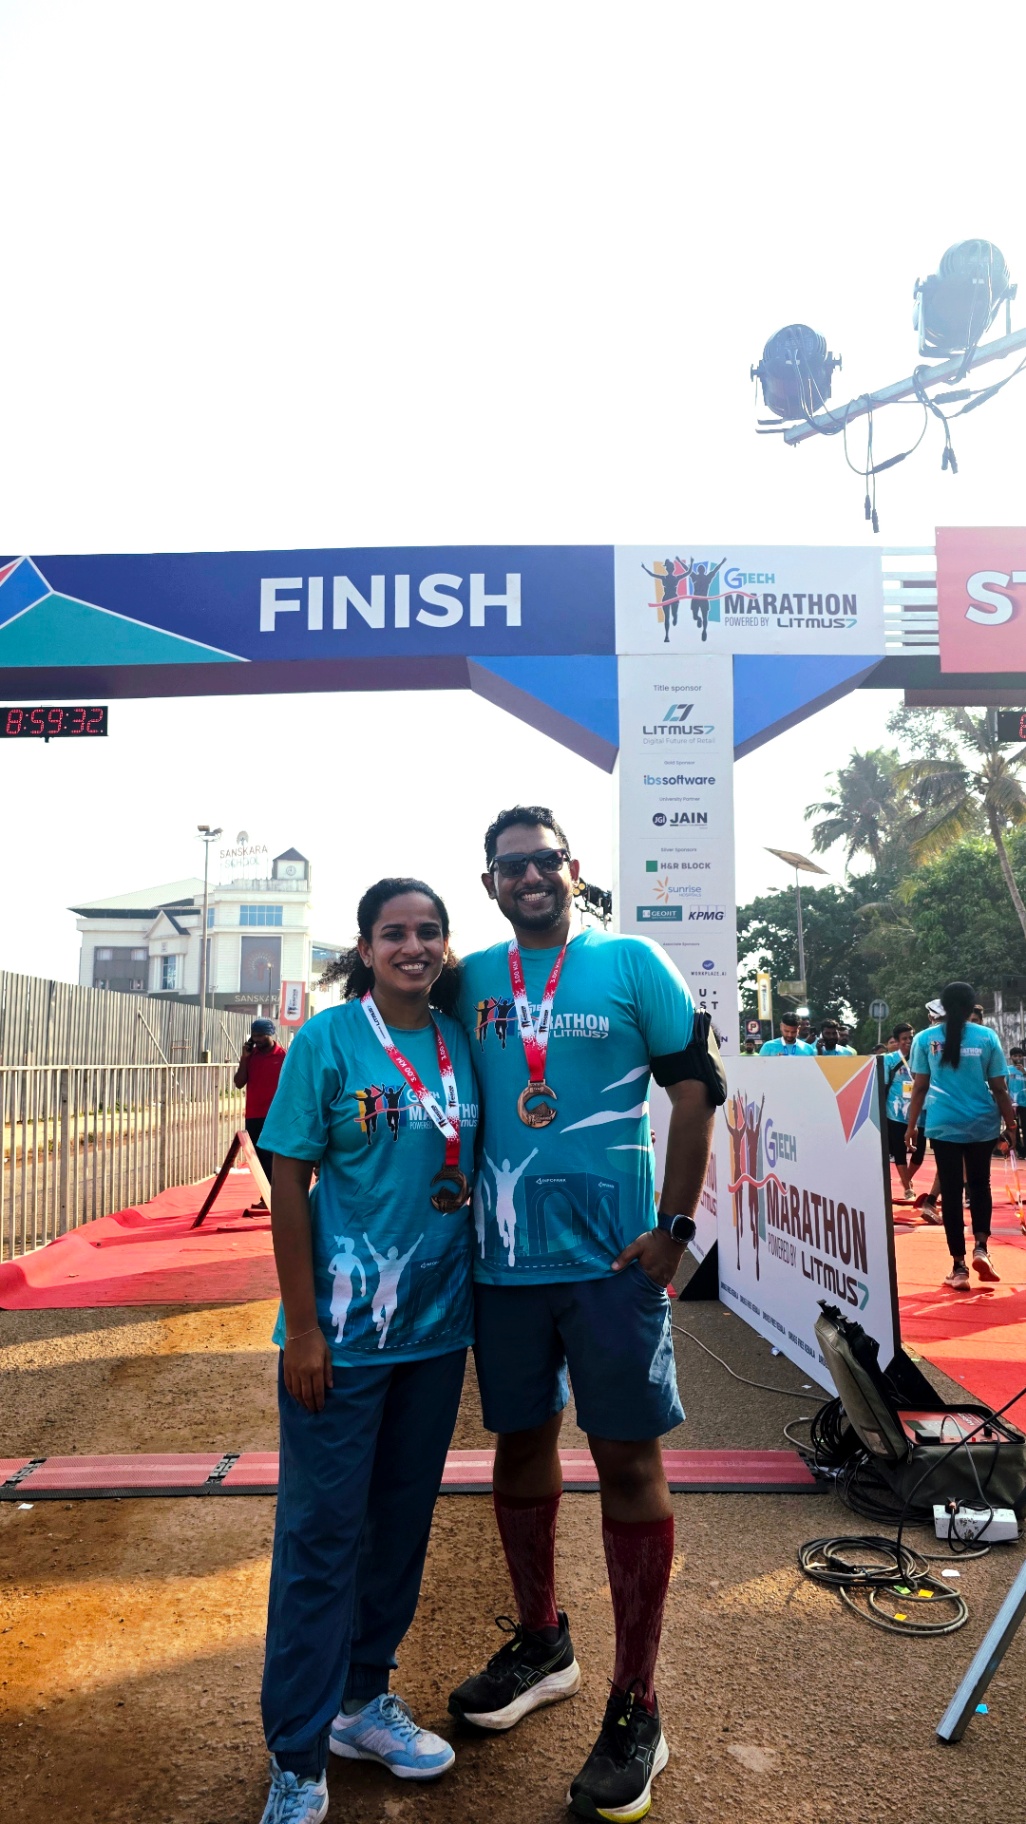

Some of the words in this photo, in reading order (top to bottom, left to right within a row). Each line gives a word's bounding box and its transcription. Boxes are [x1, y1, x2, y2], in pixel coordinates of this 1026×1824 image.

[259, 573, 522, 632] FINISH
[725, 593, 857, 615] MARATHON
[725, 617, 758, 626] POWERED
[760, 617, 769, 627] BY
[777, 618, 857, 628] LITMUS7
[671, 685, 702, 693] sponsor
[643, 725, 715, 735] LITMUS7
[670, 812, 708, 824] JAIN
[220, 845, 268, 859] SANSKARA
[668, 885, 702, 893] sunrise
[688, 911, 725, 921] KPMG
[554, 1029, 609, 1039] LITMUS7
[766, 1179, 868, 1275] MARATHON
[767, 1232, 789, 1264] POWERED
[789, 1244, 797, 1269] BY
[801, 1250, 870, 1312] LITMUS7
